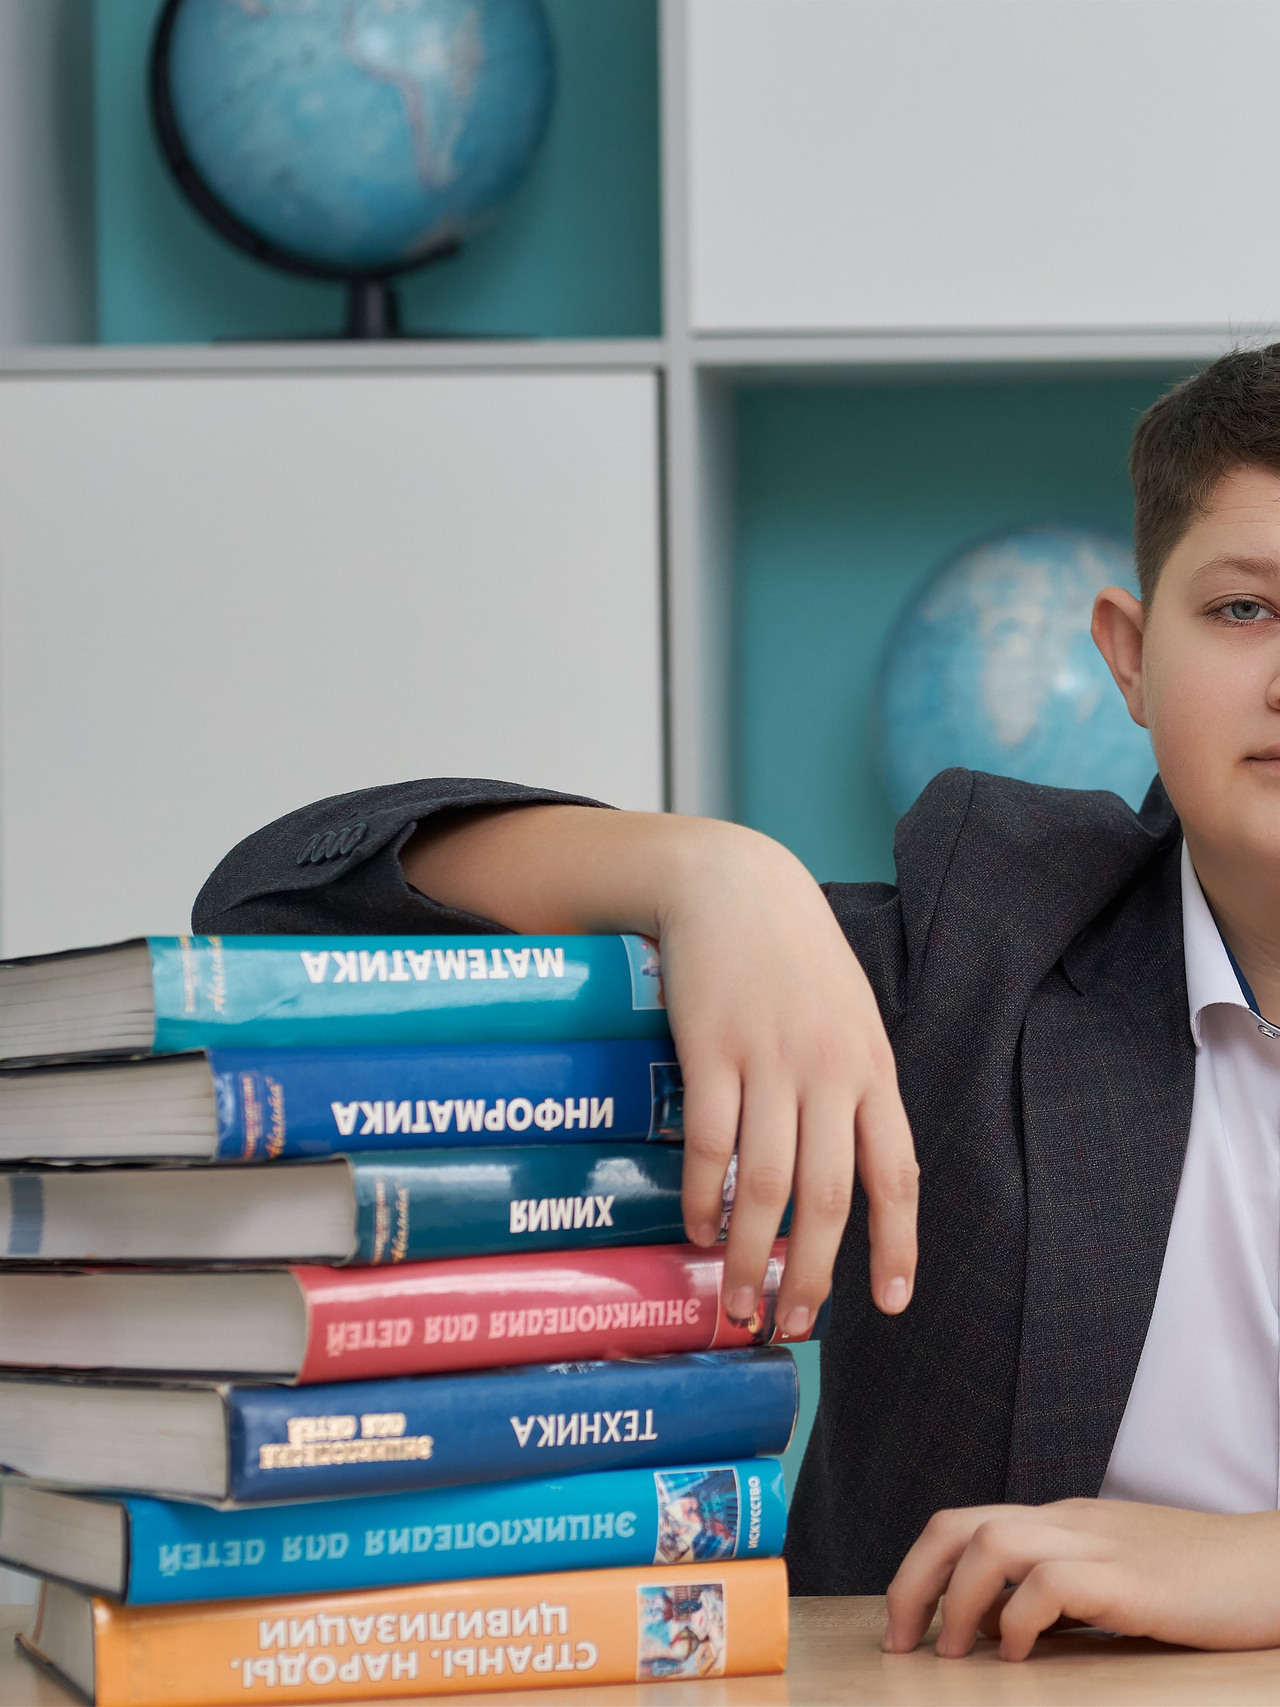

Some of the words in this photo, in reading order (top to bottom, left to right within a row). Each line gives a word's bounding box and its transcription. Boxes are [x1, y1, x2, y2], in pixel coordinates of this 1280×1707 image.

[301, 947, 564, 984] МАТЕМАТИКА
[332, 1097, 613, 1135] ИНФОРМАТИКА
[510, 1195, 614, 1233] ХИМИЯ
[424, 1314, 479, 1342] ДЛЯ
[489, 1297, 700, 1338] ЭНЦИКЛОПЕДИЯ
[326, 1318, 413, 1356] ДЕТЕЙ
[510, 1409, 658, 1447] ТЕХНИКА
[747, 1475, 762, 1549] ИСКУССТВО
[282, 1532, 350, 1562] ДЛЯ
[364, 1511, 637, 1554] ЭНЦИКЛОПЕДИЯ
[159, 1539, 265, 1577] ДЕТЕЙ
[259, 1603, 569, 1648] ЦИВИЛИЗАЦИИ
[230, 1649, 419, 1687] НАРОДЫ.
[431, 1639, 598, 1676] СТРАНЫ.
